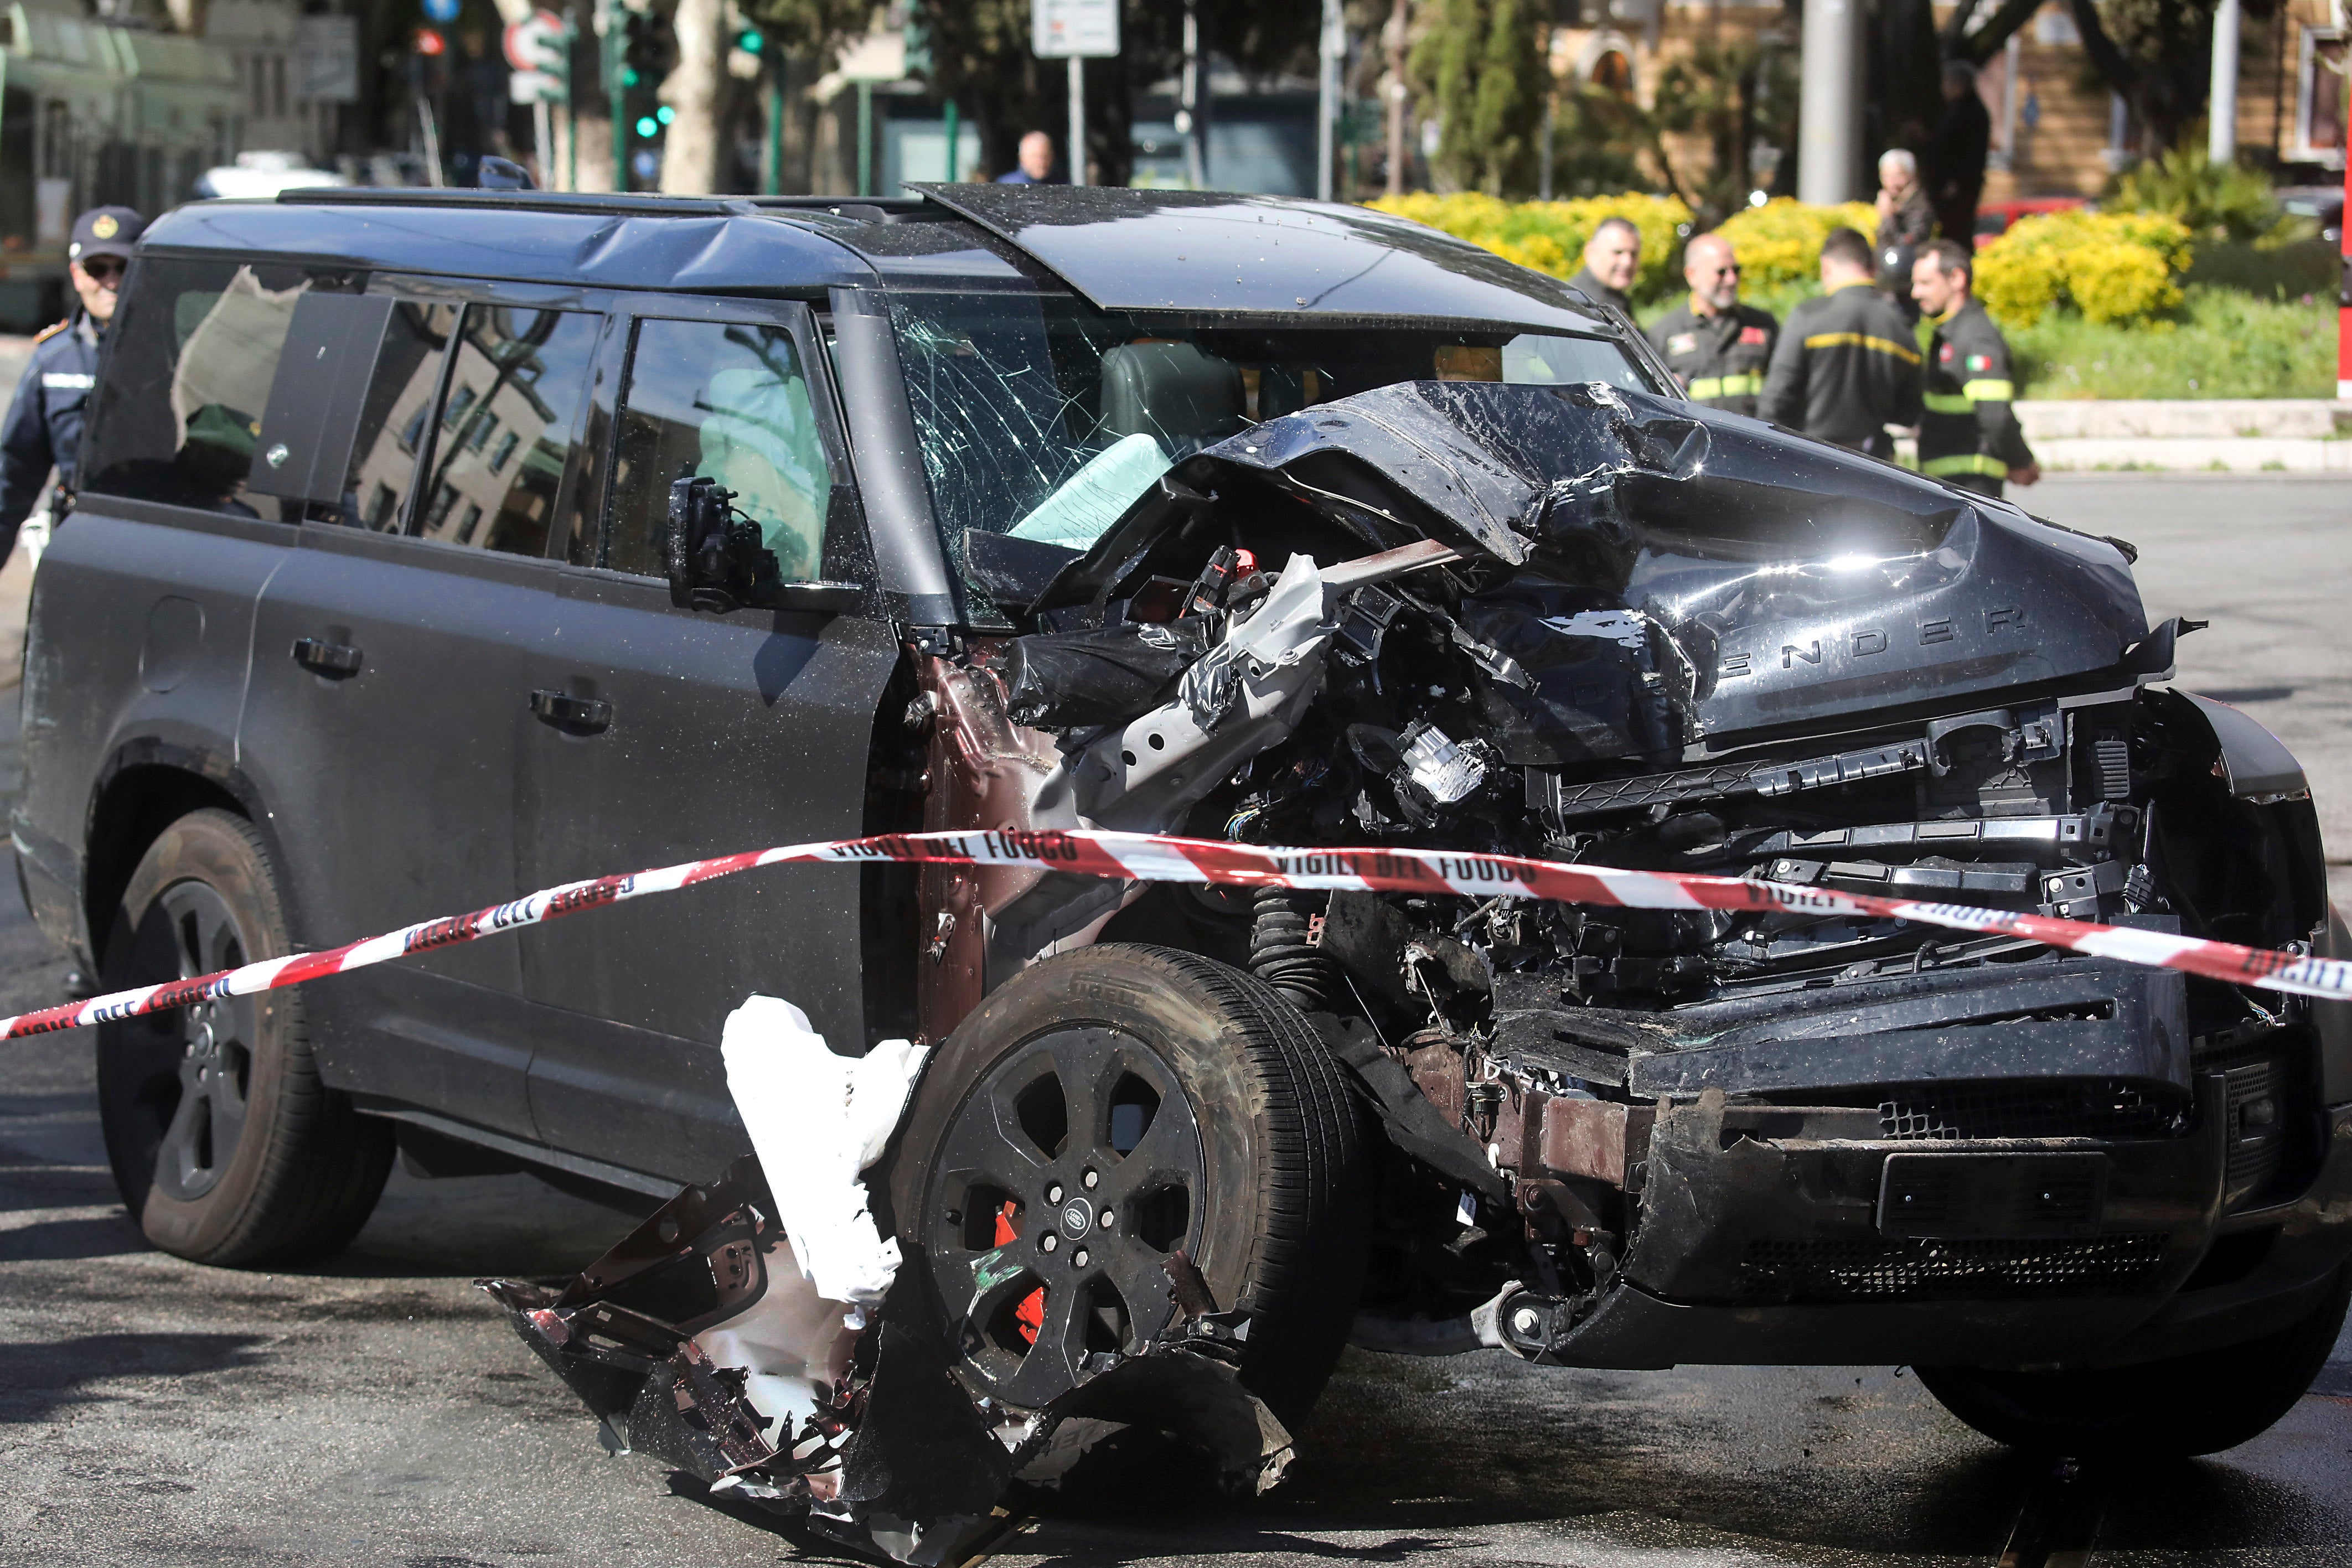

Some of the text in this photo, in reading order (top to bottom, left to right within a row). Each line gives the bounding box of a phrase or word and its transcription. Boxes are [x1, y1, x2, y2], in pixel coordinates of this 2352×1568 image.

[1278, 852, 1537, 883] VIGILI DEL FUOCO
[1068, 1215, 1081, 1227] ROVER
[1069, 1210, 1081, 1221] LAND
